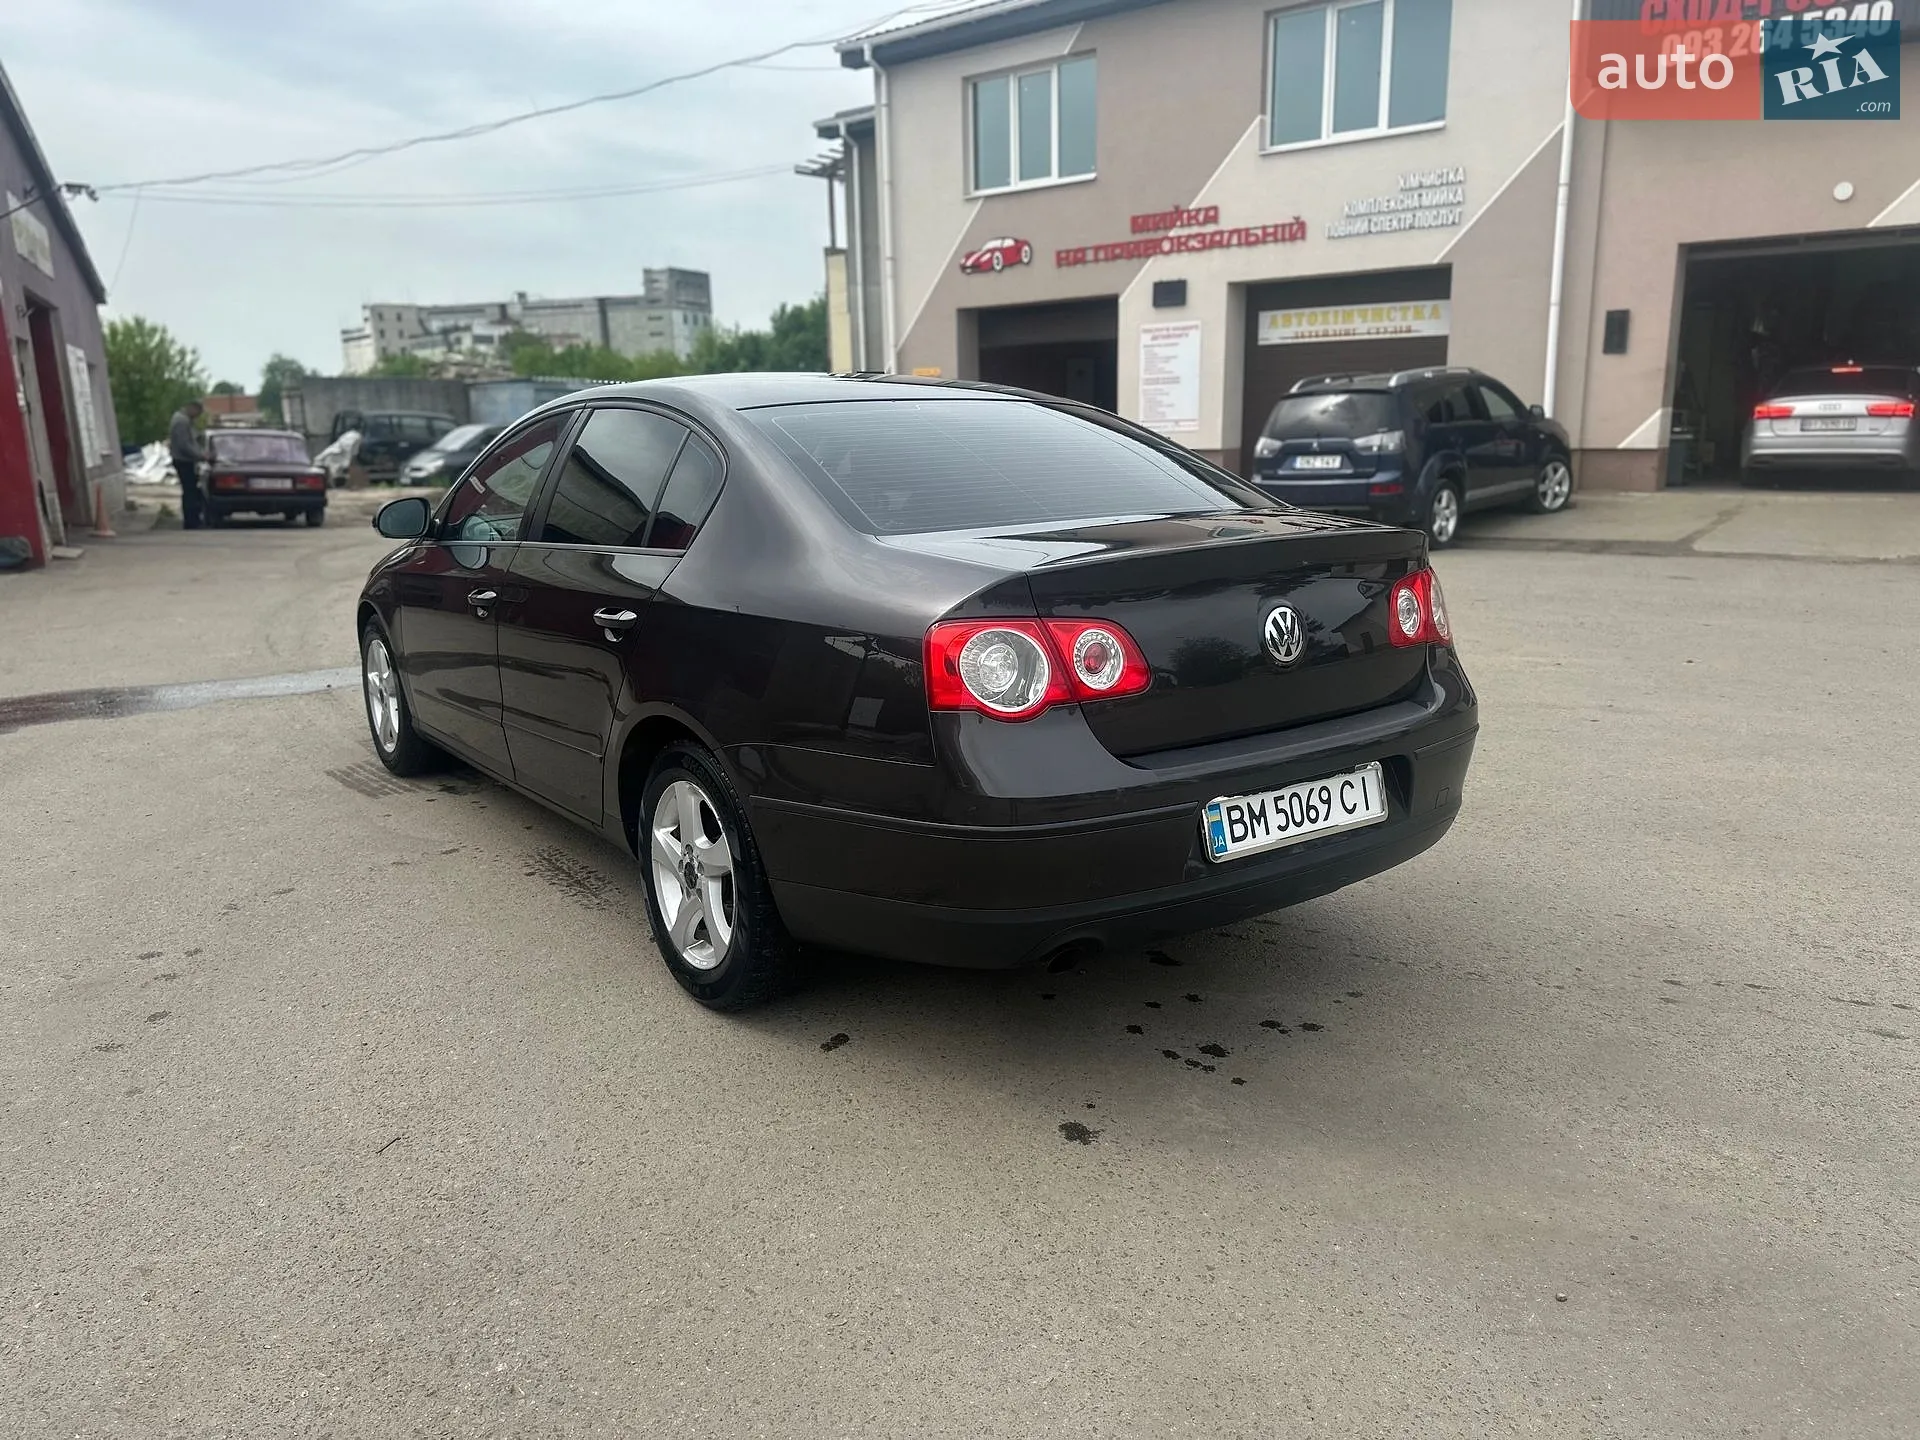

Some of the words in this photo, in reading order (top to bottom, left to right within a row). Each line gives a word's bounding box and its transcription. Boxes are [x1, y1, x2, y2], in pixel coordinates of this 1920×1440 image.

[1398, 166, 1464, 191] ХІМЧИСТКА
[1130, 205, 1219, 234] МИЙКА
[1056, 247, 1087, 268] НА
[1092, 216, 1307, 262] ПРИВОКЗАЛЬНІЙ
[1268, 304, 1442, 329] АВТОХІМЧИСТКА
[1226, 799, 1271, 844] BM
[1273, 785, 1332, 832] 5069
[1339, 776, 1371, 815] CI
